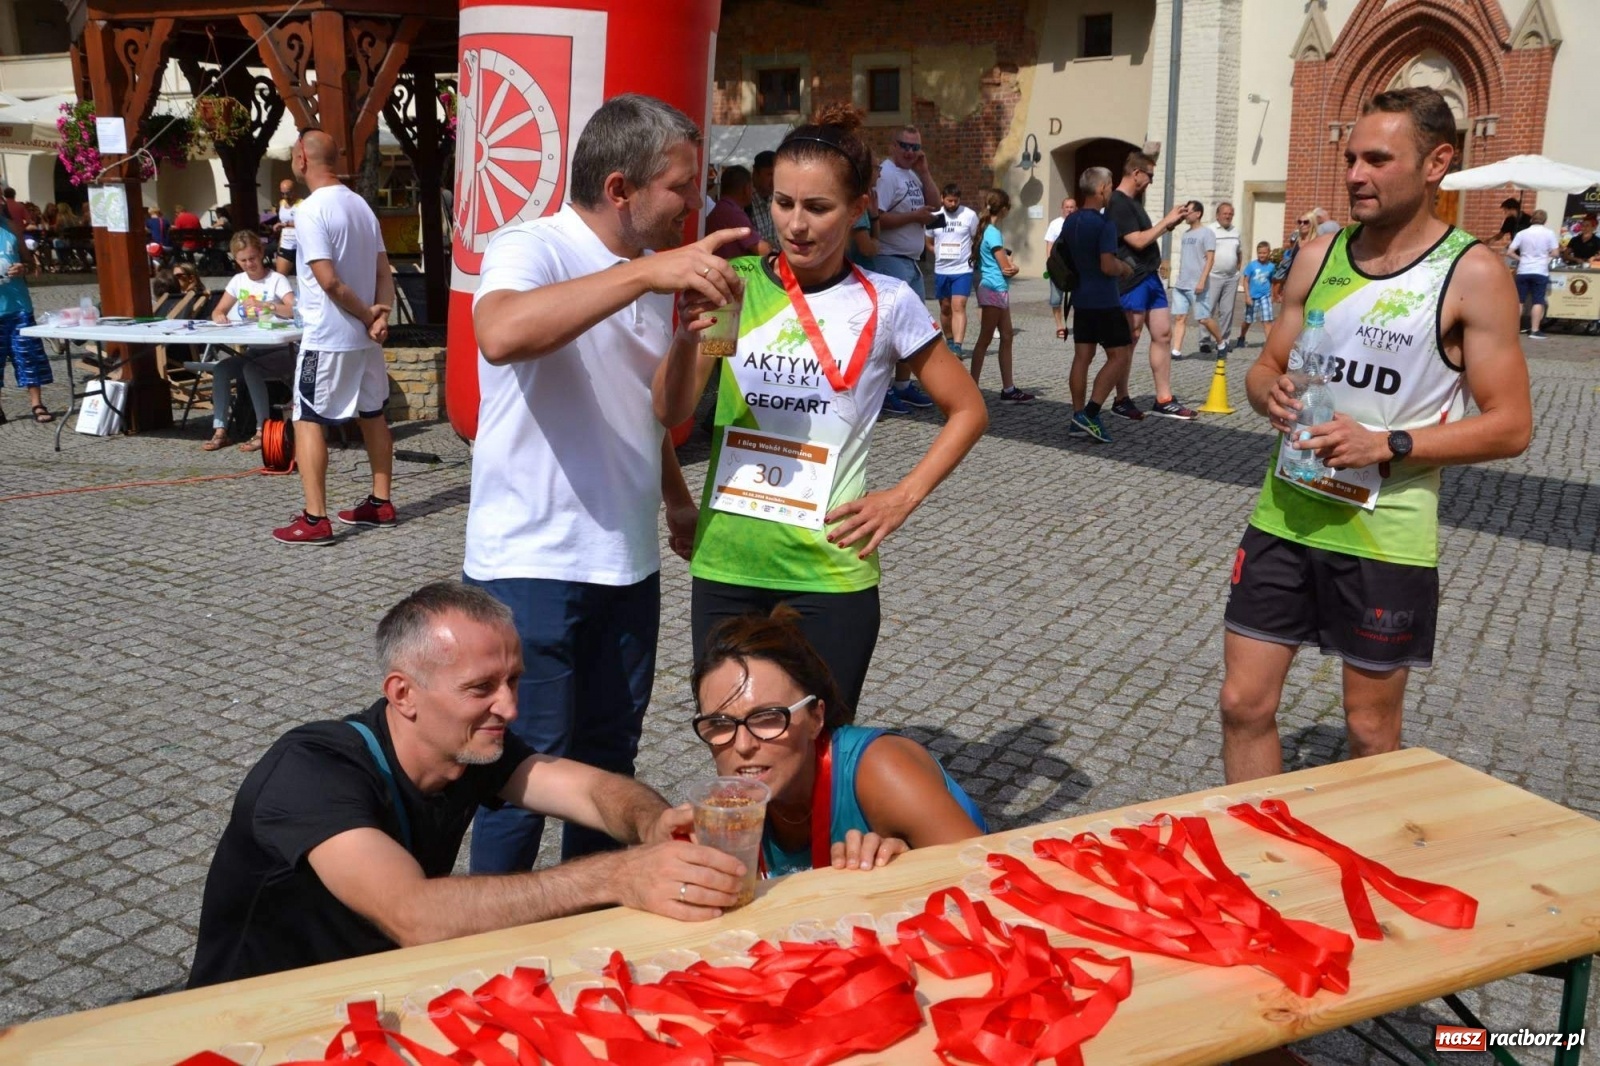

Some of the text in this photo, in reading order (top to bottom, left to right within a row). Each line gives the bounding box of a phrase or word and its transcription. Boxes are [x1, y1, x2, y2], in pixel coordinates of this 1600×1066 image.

[1049, 117, 1062, 136] D
[1355, 325, 1413, 347] AKTYWNI
[1363, 339, 1399, 352] LYSKI
[743, 352, 843, 376] AKTYWI
[763, 371, 820, 387] LYSKI
[745, 392, 831, 415] GEOFART
[742, 439, 757, 449] Bieg
[753, 463, 783, 487] 30
